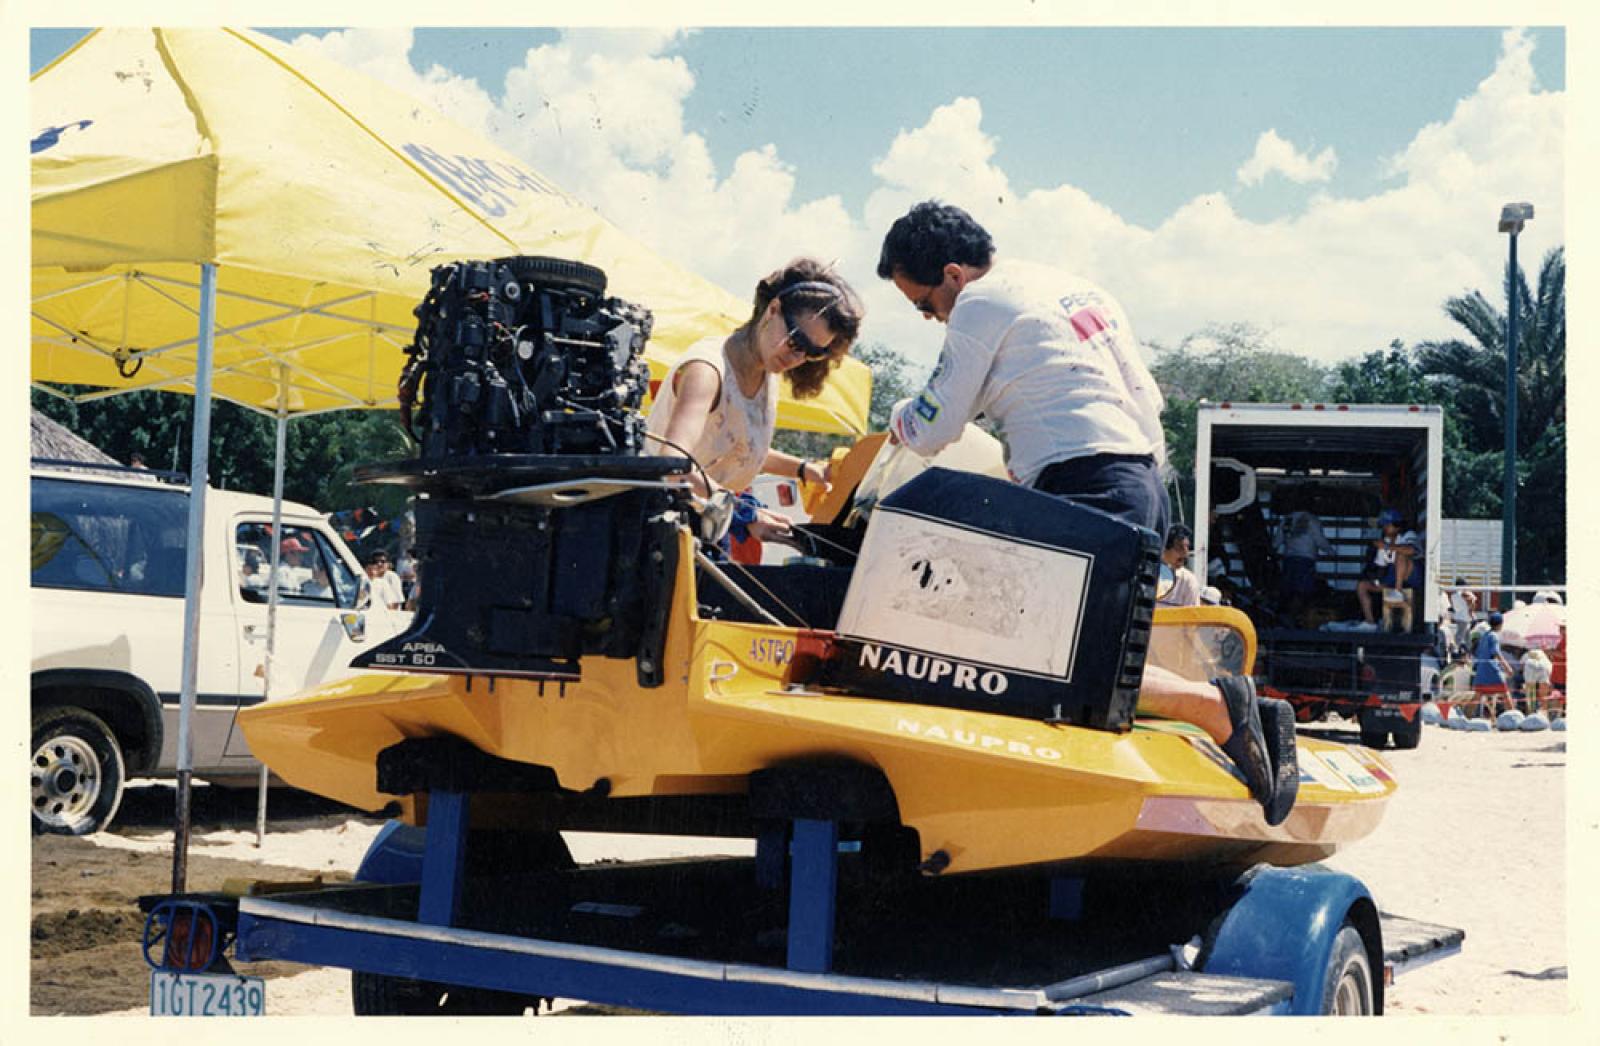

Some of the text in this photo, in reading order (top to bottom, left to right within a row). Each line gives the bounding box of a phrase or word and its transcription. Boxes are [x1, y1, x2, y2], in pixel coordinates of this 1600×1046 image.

[375, 653, 407, 664] SST
[402, 642, 446, 654] APBA
[859, 644, 1009, 695] NAUPRO
[896, 719, 1062, 760] NAUPRO
[159, 979, 262, 1016] 1GT2439
